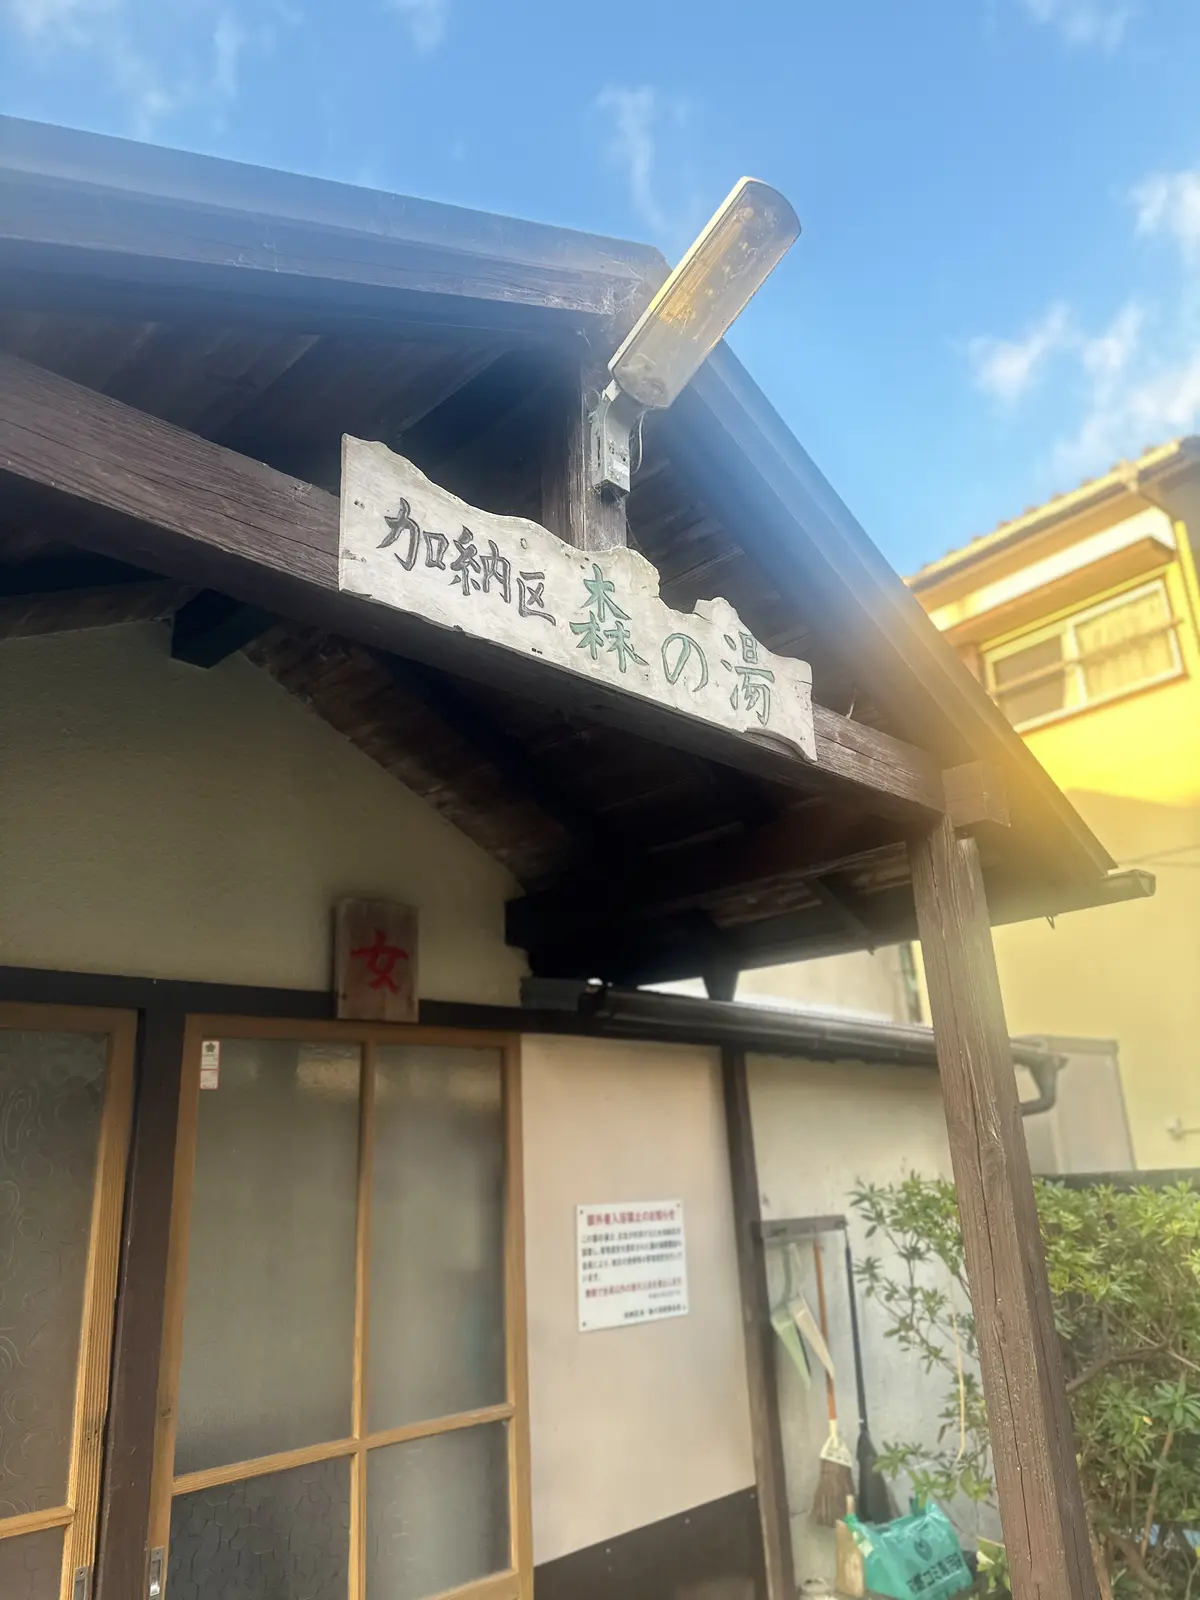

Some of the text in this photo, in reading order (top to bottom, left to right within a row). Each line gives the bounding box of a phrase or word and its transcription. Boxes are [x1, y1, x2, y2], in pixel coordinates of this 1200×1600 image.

[376, 497, 775, 727] 加納区 森の湯
[350, 926, 409, 995] 女
